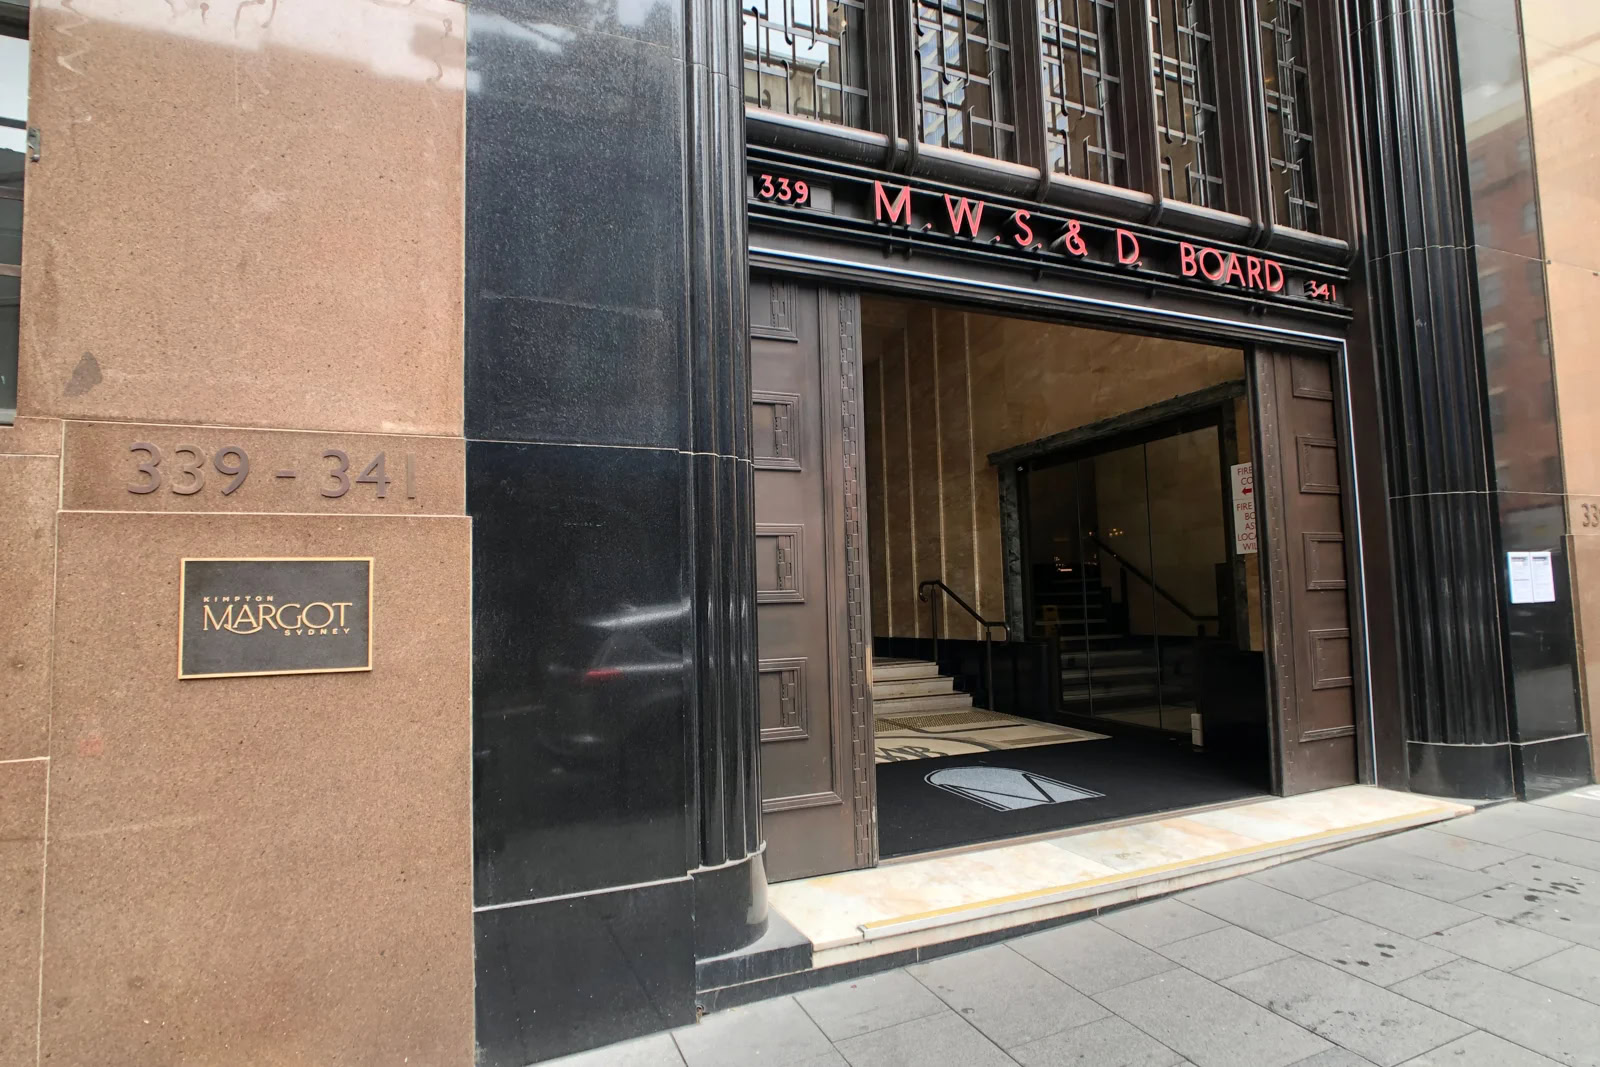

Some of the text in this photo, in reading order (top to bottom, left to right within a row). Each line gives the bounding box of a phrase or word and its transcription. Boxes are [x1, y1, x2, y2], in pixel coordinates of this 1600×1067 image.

[761, 174, 809, 204] 339
[1065, 219, 1089, 257] &
[1180, 242, 1285, 293] BOARD
[1308, 280, 1337, 302] 341
[1236, 502, 1253, 511] FIRE
[1581, 503, 1600, 528] 33
[1244, 522, 1256, 531] AS
[203, 595, 274, 603] KIMPTON
[203, 602, 353, 635] MARGOT
[284, 627, 350, 637] SYDNEY
